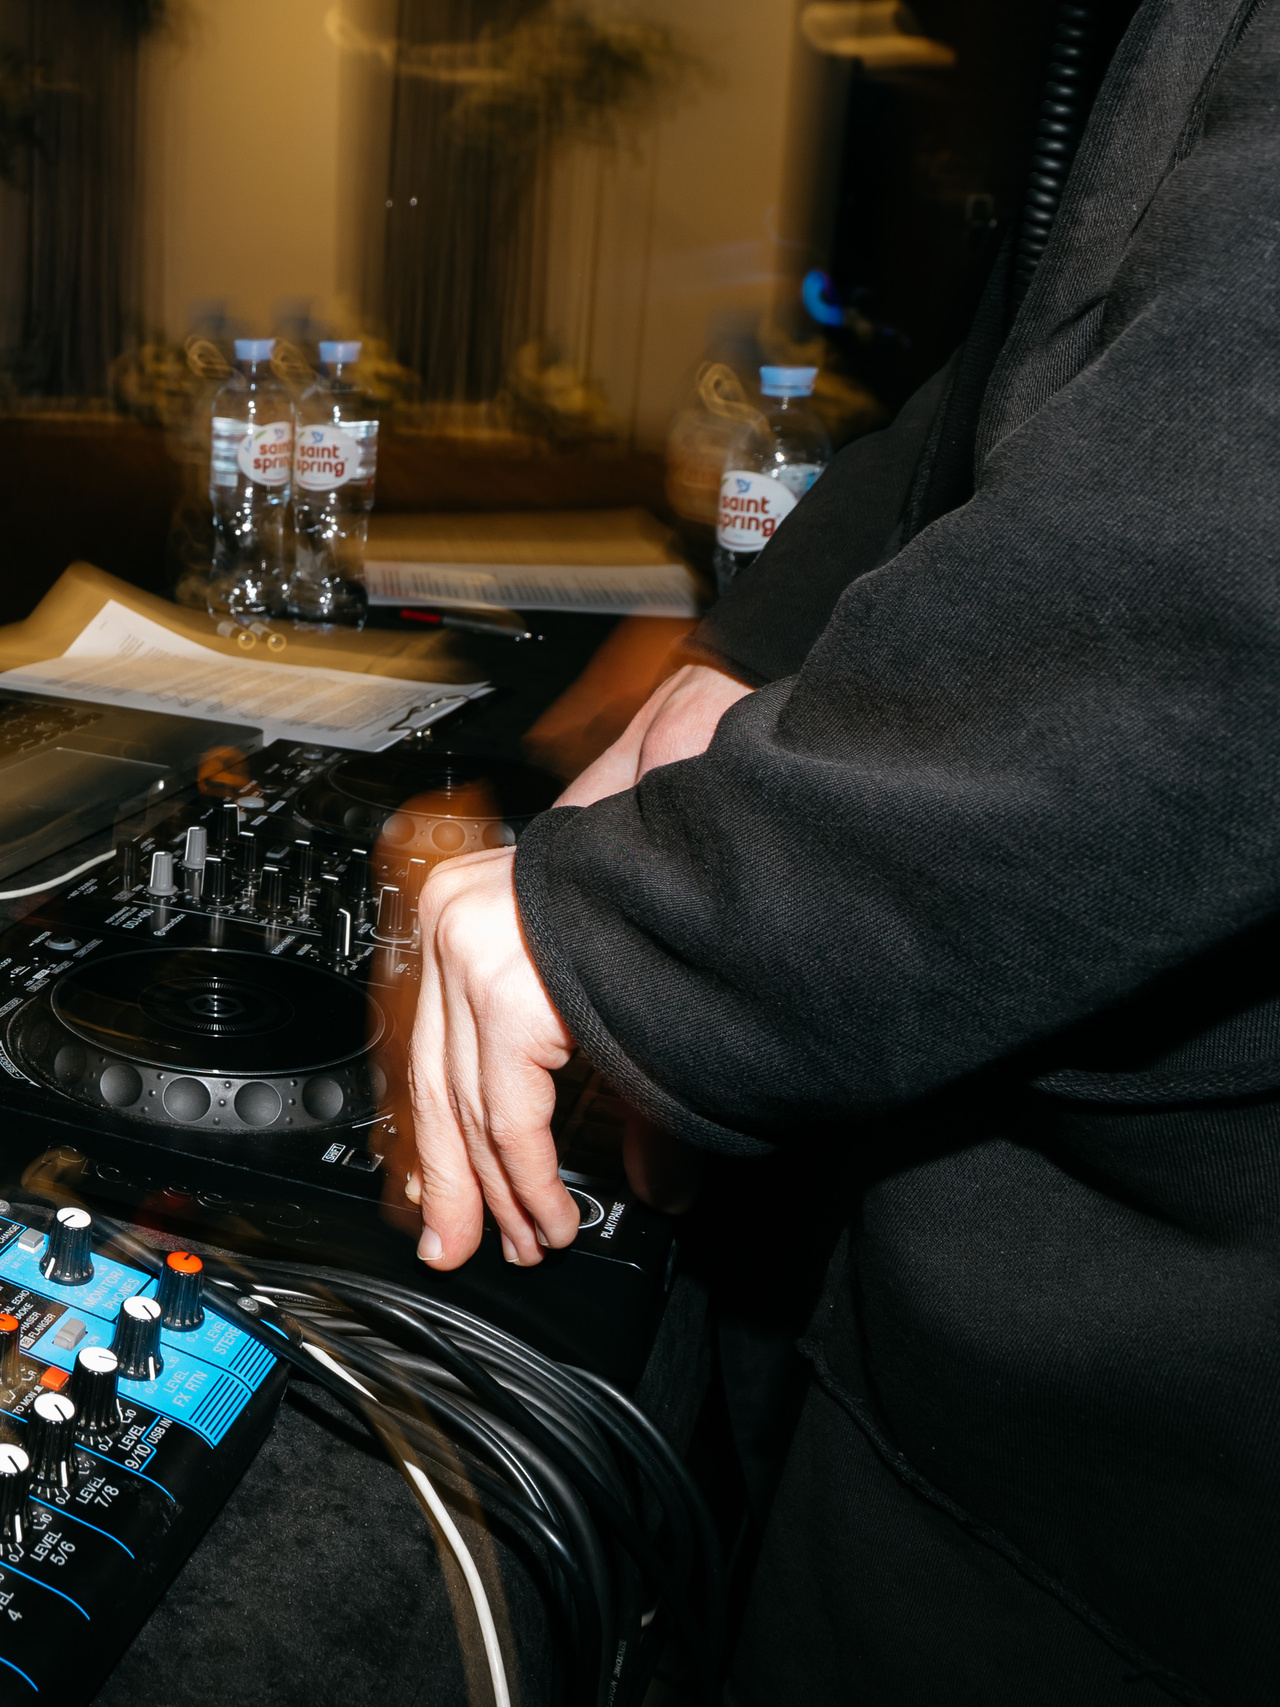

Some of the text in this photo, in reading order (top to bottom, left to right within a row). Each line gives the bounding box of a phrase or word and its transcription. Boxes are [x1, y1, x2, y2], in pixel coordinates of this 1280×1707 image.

[722, 496, 769, 514] saint
[11, 966, 26, 974] CALL
[326, 1146, 341, 1160] SHIFT
[600, 1201, 625, 1239] PLAY/PAUSE
[12, 1290, 29, 1304] ECHO
[83, 1269, 124, 1309] MONITOR/
[104, 1278, 141, 1310] PHONES
[28, 1313, 56, 1338] FLANGER
[204, 1320, 227, 1341] LEVEL
[163, 1370, 189, 1394] LEVEL
[173, 1371, 208, 1407] FX RTN
[12, 1392, 37, 1415] TO MON
[118, 1424, 146, 1451] LEVEL
[149, 1417, 173, 1444] USB IN
[98, 1442, 108, 1451] 0
[125, 1445, 151, 1470] 9/10
[55, 1495, 65, 1505] 0
[76, 1475, 106, 1504] LEVEL
[94, 1485, 119, 1508] 7/8
[40, 1513, 53, 1527] 10
[30, 1530, 62, 1562] LEVEL
[50, 1541, 76, 1566] 5/6
[9, 1554, 19, 1562] 0
[8, 1609, 22, 1622] 4
